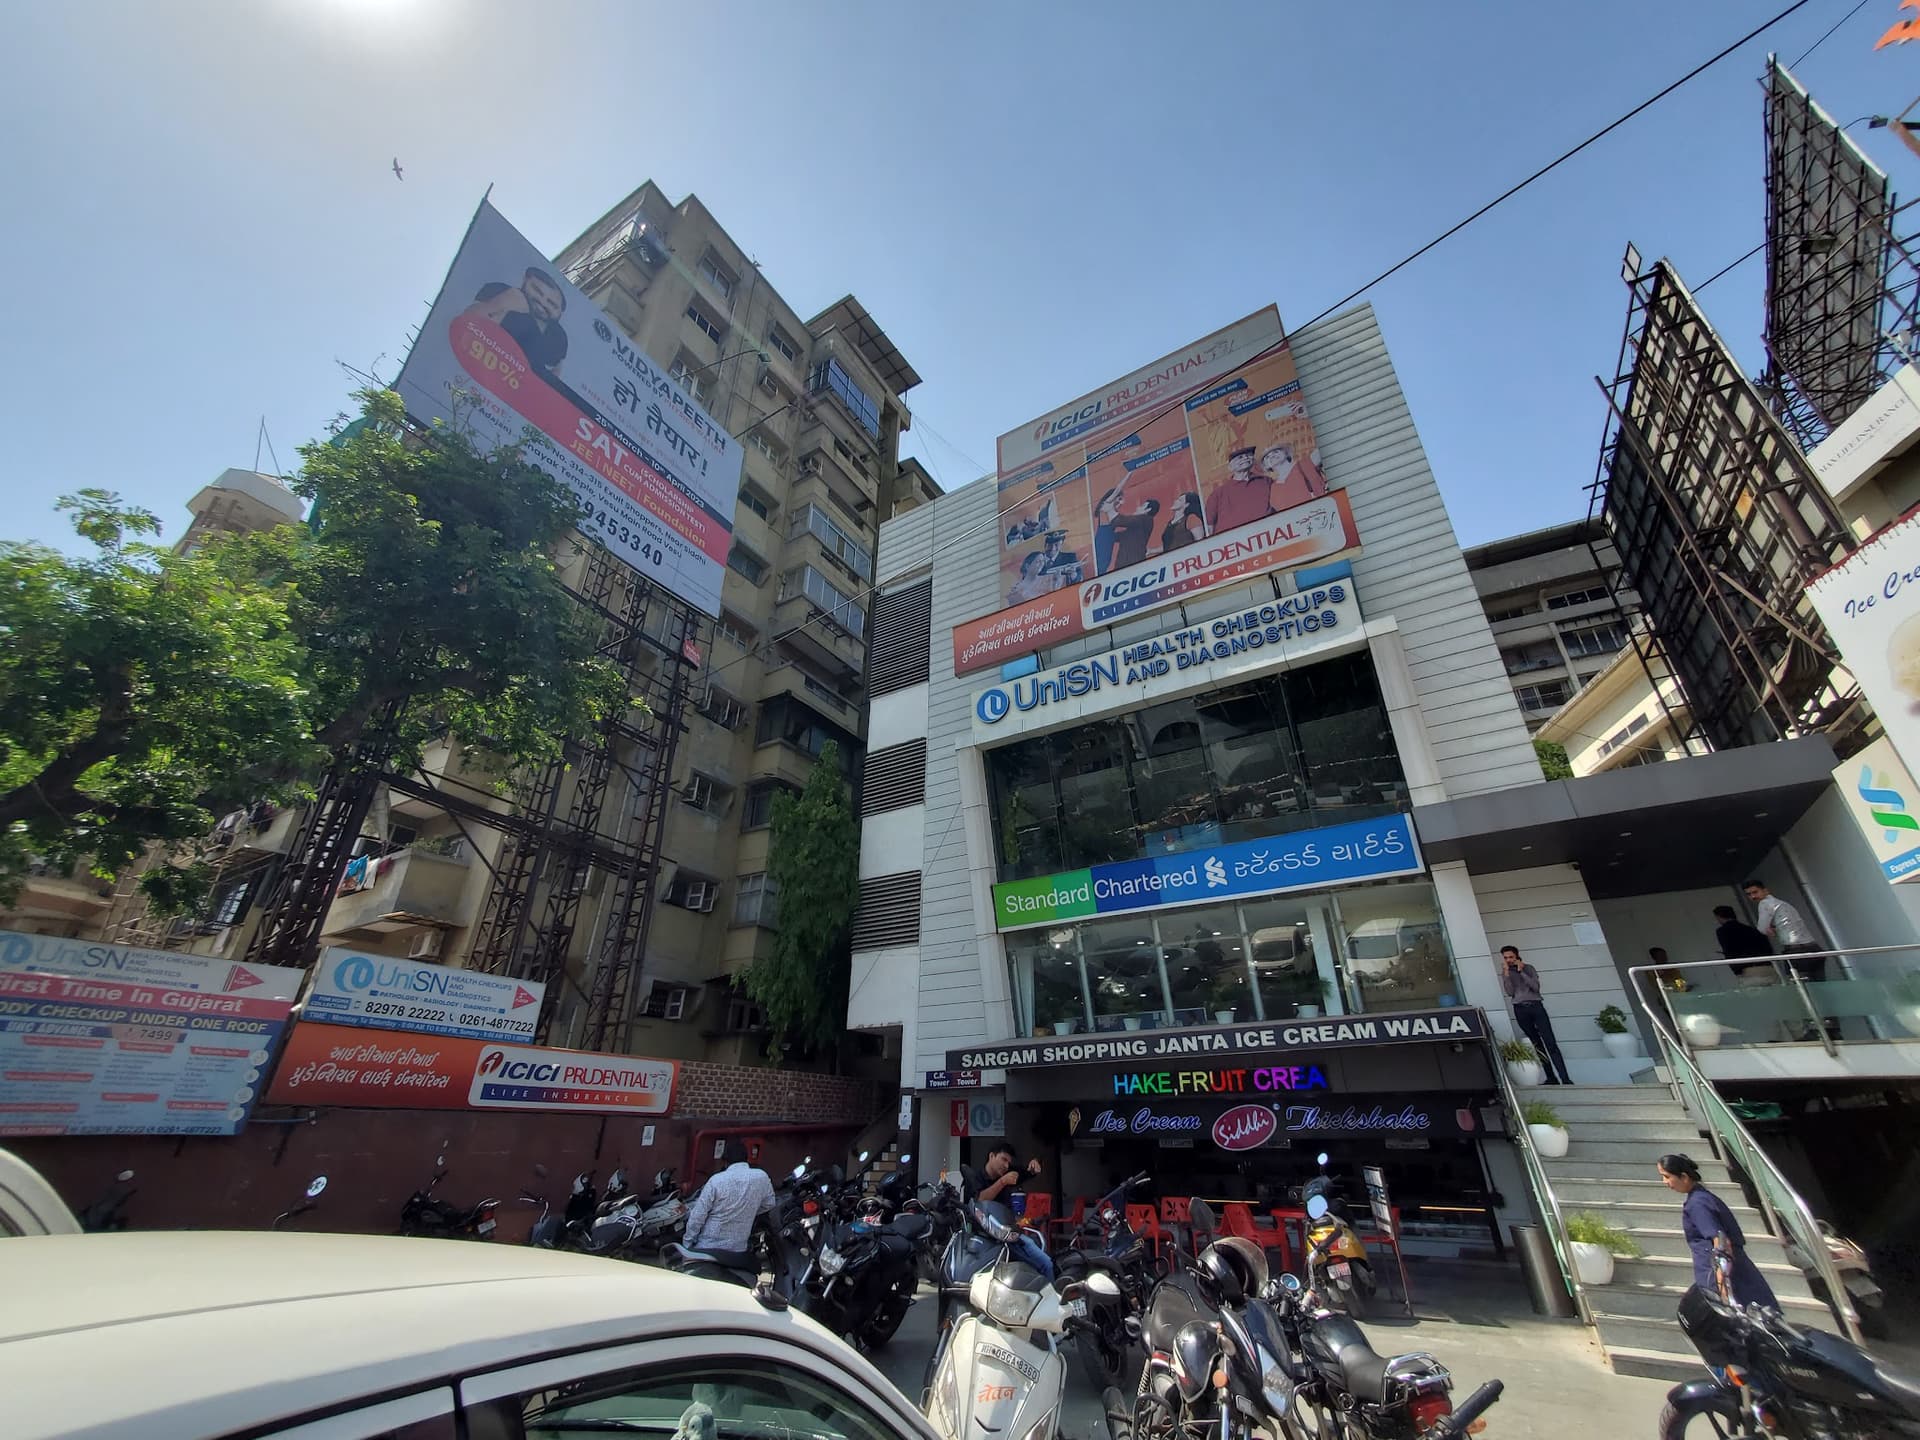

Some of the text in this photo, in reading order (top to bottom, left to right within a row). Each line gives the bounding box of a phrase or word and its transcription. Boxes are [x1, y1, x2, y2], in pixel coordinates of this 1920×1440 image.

[466, 321, 525, 373] Scholarship
[469, 340, 520, 391] 90%
[612, 349, 649, 388] POWERED
[652, 386, 662, 399] BY
[612, 376, 641, 413] हो
[616, 336, 725, 449] VIDYAPEETH
[1051, 354, 1208, 434] ICICI PRUDENTIAL
[576, 417, 628, 466] SAT
[614, 429, 642, 458] March
[665, 472, 684, 495] April
[686, 488, 704, 508] 2023
[623, 462, 642, 483] CUM
[643, 477, 686, 518] ADMISSION
[552, 447, 568, 464] No.
[624, 500, 663, 538] Shoppers,
[665, 530, 683, 549] Near
[684, 544, 706, 567] Siddhi
[560, 465, 596, 499] Temple,
[597, 493, 618, 513] Vesu
[619, 508, 640, 529] Main
[641, 524, 662, 545] Road
[663, 541, 681, 560] Vesu
[570, 440, 593, 459] JEE
[602, 463, 635, 490] NEET
[643, 494, 705, 548] Foundation
[1104, 522, 1300, 602] ICICI PRUDENTIAL
[1101, 555, 1274, 616] LIFE INSURANCE
[1844, 595, 1877, 618] Ice
[1124, 585, 1346, 666] HEALTH CHECKUPS
[1126, 610, 1338, 685] AND DIAGNOSTICS
[1014, 655, 1120, 711] UniSN
[1005, 865, 1198, 915] Standard Chartered
[34, 939, 129, 970] UniSN
[60, 981, 122, 1001] Time
[124, 987, 151, 1004] In
[158, 990, 244, 1015] Gujarat
[376, 965, 450, 995] UniSN
[446, 990, 492, 1002] DIAGNOSTICS
[448, 983, 464, 991] AND
[450, 974, 512, 991] HEALTH CHECKUPS
[37, 1004, 127, 1023] CHECKUP
[130, 1012, 187, 1027] UNDER
[189, 1017, 222, 1029] ONE
[228, 1020, 268, 1033] ROOF
[138, 1028, 173, 1040] 7499
[364, 1001, 406, 1016] 82978
[407, 1007, 446, 1021] 22222
[458, 1013, 534, 1032] 0261-4877222
[961, 1016, 1472, 1068] SARGAM SHOPPING JANTA ICE CREAM WALA
[490, 1087, 630, 1102] LIFE INSURANCE
[498, 1061, 650, 1088] ICICI PRUDENTIAL
[957, 1078, 978, 1086] Tower
[1254, 1065, 1327, 1091] CREA
[1089, 1107, 1202, 1134] Ice Cream
[1219, 1110, 1271, 1146] Siddhi
[1286, 1105, 1430, 1131] Thickshake
